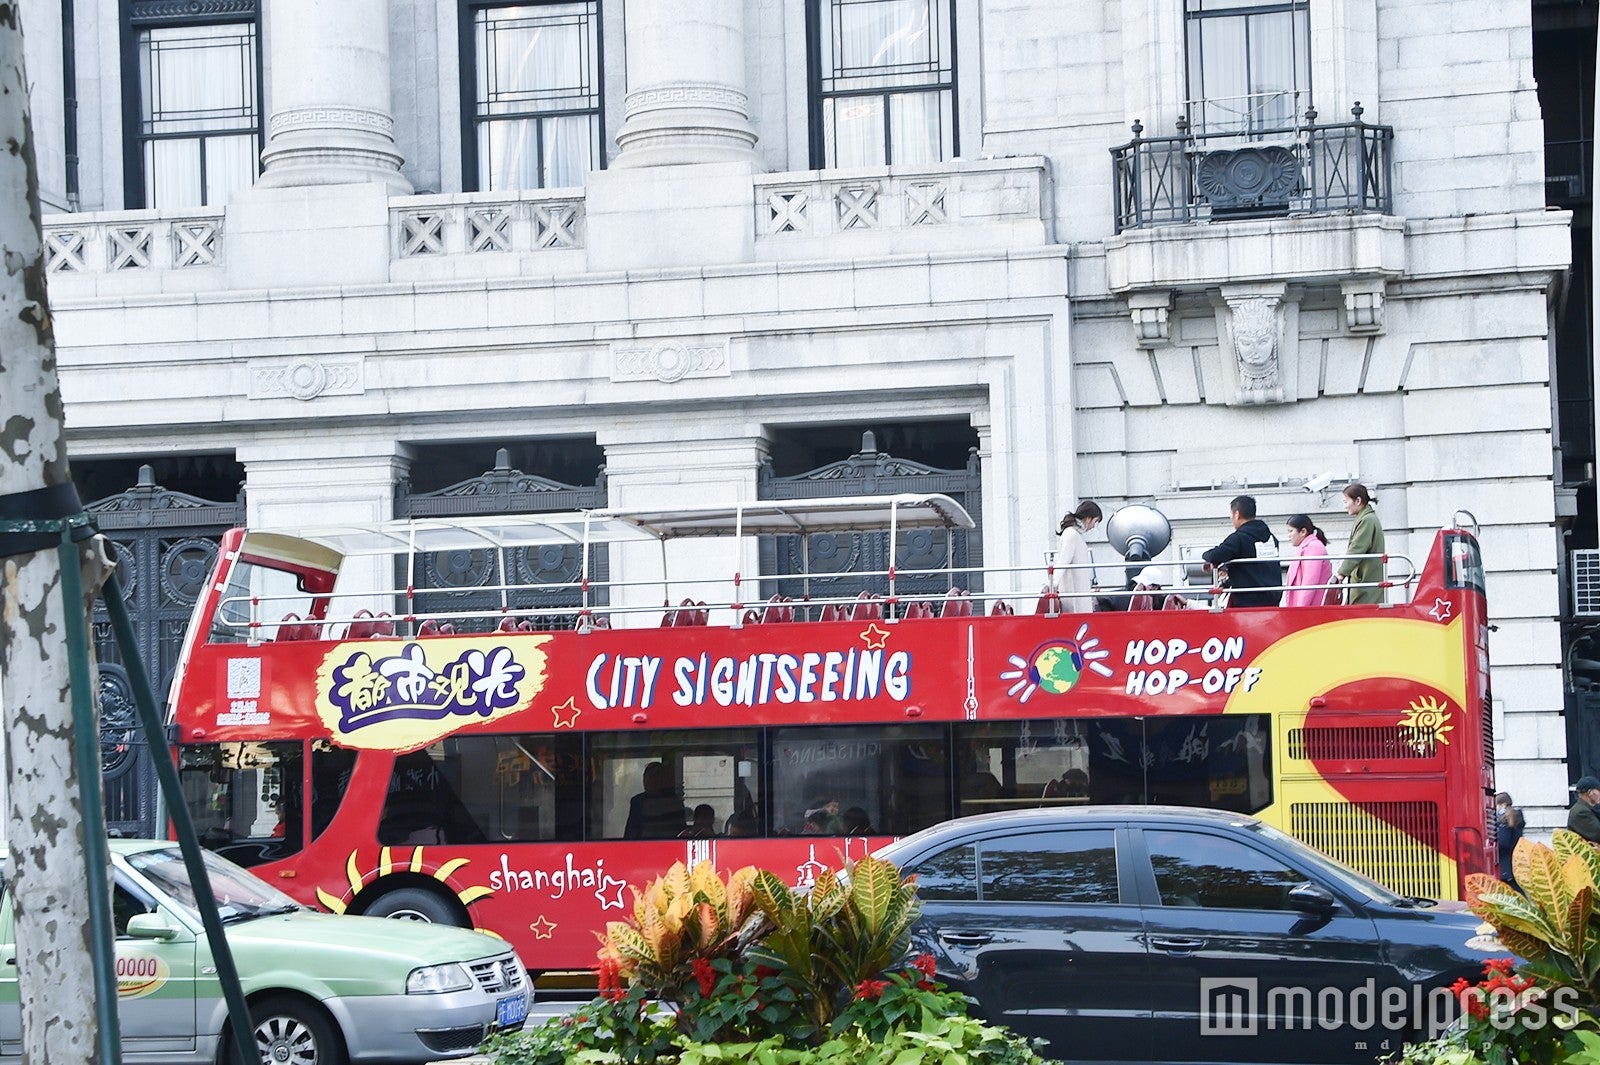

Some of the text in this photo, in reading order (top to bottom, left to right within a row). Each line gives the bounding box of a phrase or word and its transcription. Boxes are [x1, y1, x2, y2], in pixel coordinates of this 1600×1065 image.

[1124, 636, 1245, 666] HOP-ON
[336, 644, 526, 722] 都市观光
[585, 646, 914, 709] CITY SIGHTSEEING
[1124, 667, 1263, 696] HOP-OFF
[489, 852, 604, 899] shanghai
